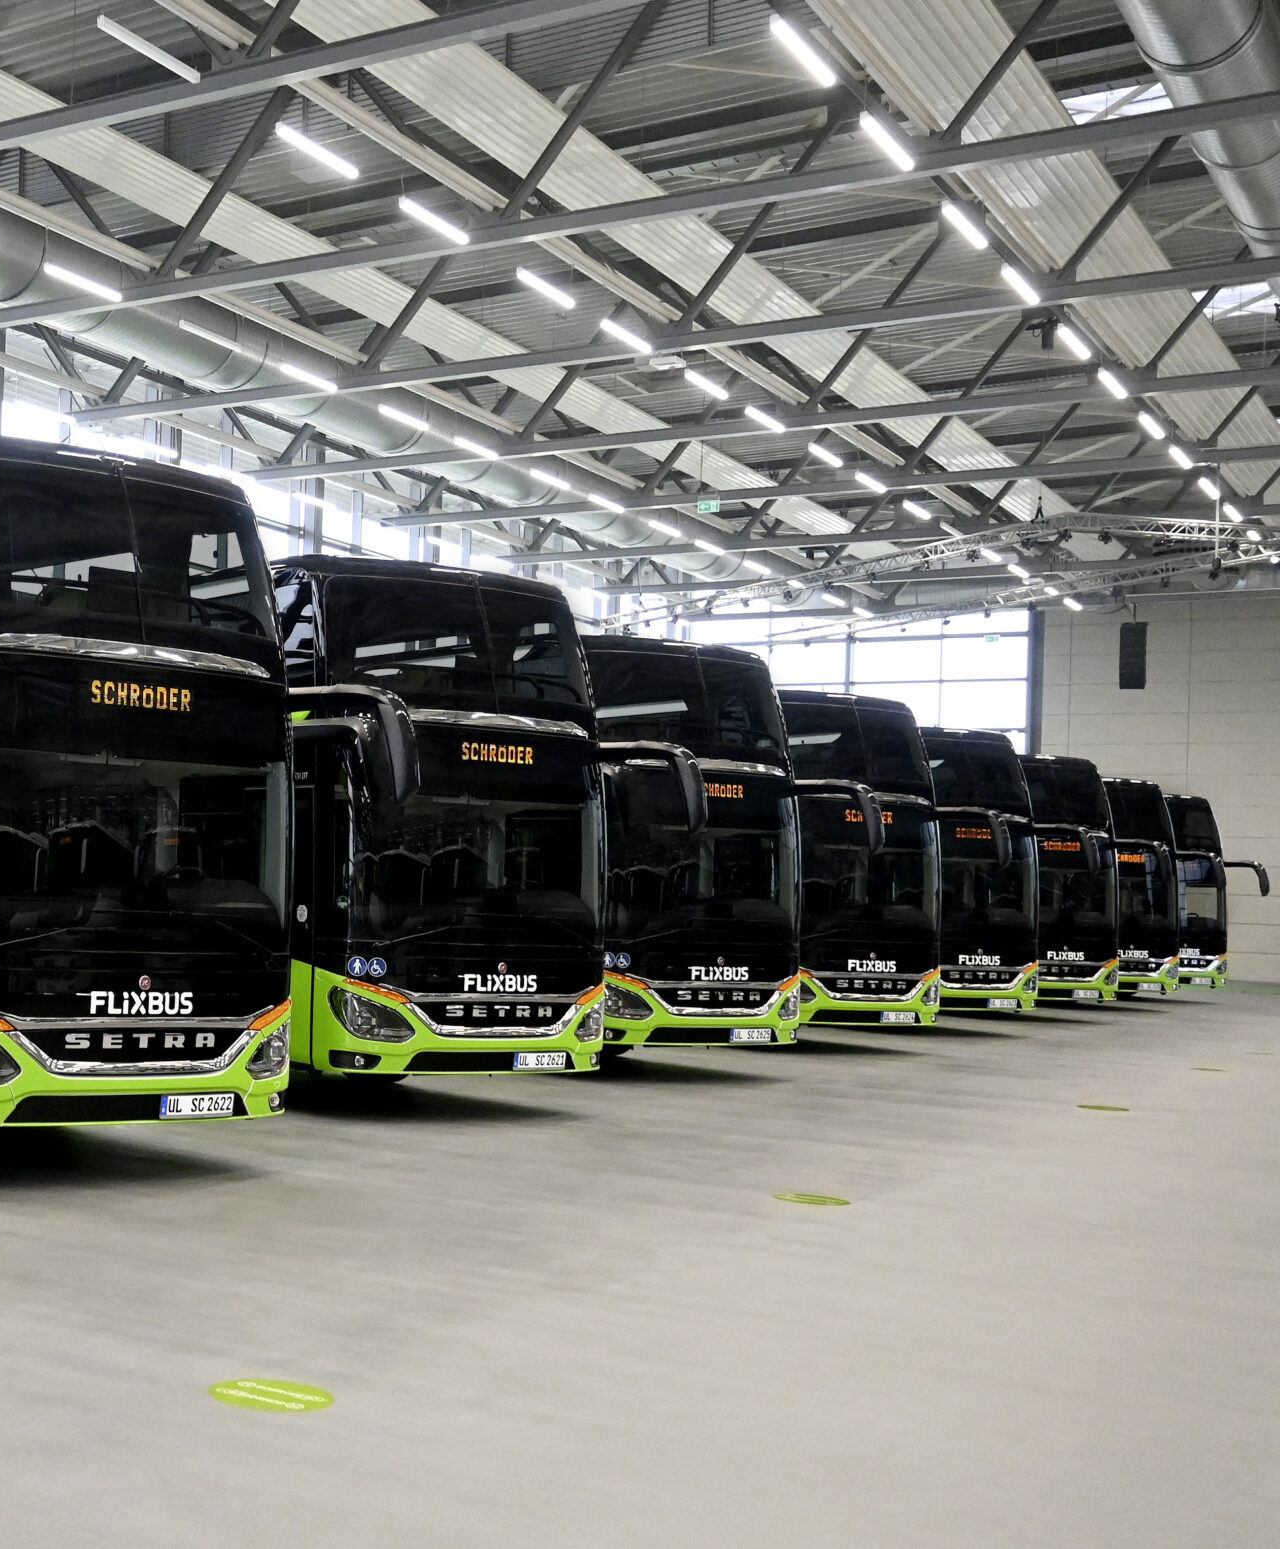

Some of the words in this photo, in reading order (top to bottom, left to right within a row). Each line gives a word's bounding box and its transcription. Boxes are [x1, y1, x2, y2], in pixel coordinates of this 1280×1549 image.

[91, 680, 191, 711] SCHRÖDER
[462, 742, 532, 764] SCHRÖDER
[836, 980, 906, 989] SETRA
[677, 991, 760, 1001] SETRA
[446, 1005, 552, 1017] SETRA
[65, 1033, 215, 1049] SETRA
[519, 1055, 529, 1066] UL
[535, 1055, 545, 1066] SC
[546, 1054, 564, 1066] 2621
[168, 1098, 182, 1113] UL
[191, 1098, 205, 1112] SC
[207, 1096, 232, 1111] 2622
